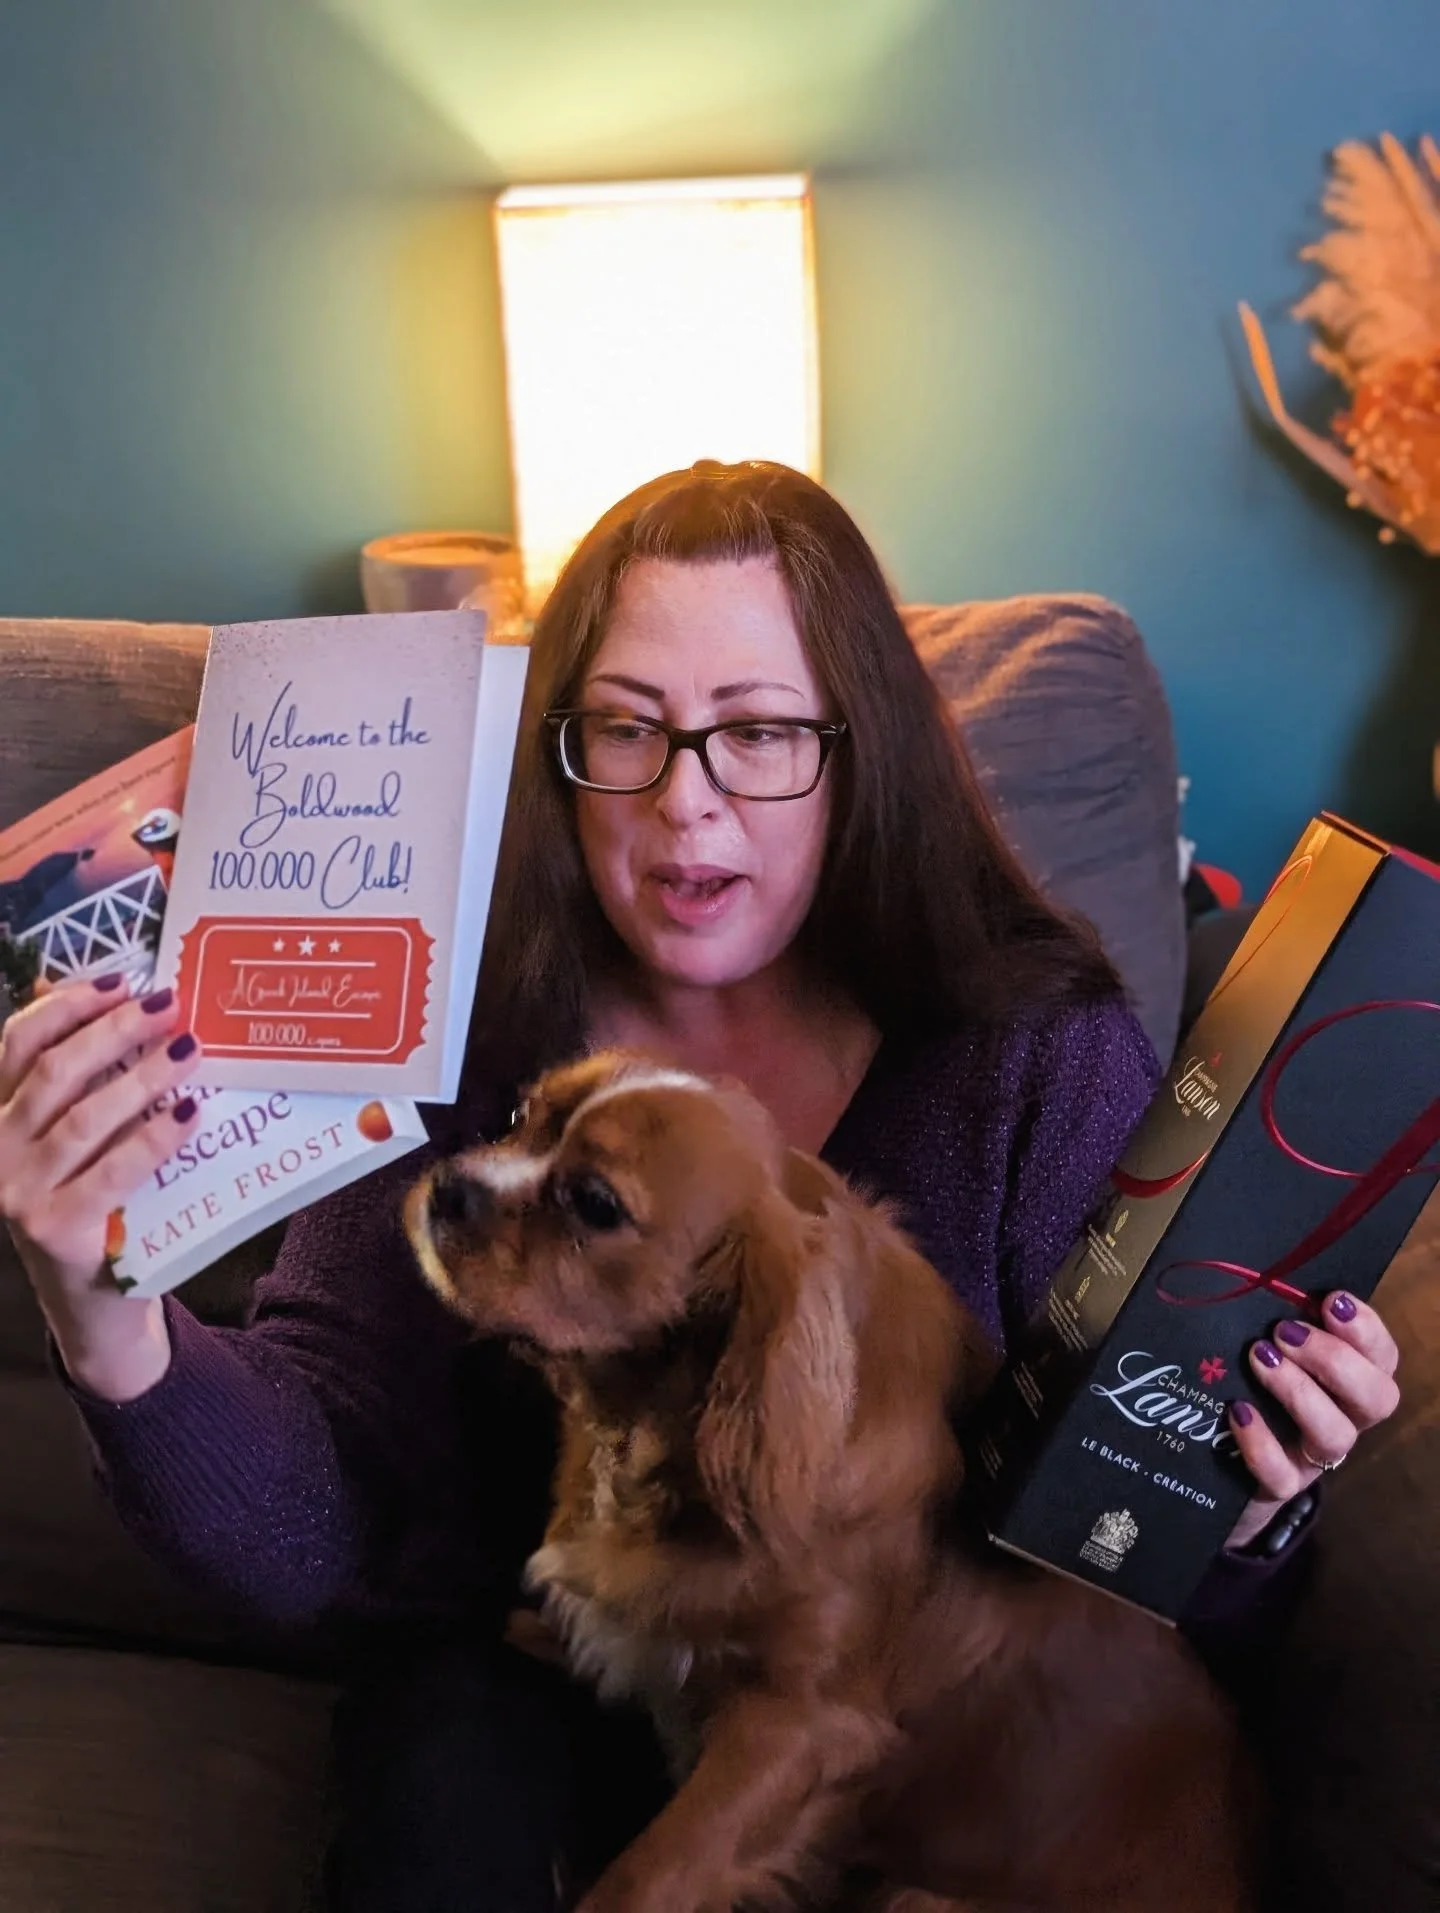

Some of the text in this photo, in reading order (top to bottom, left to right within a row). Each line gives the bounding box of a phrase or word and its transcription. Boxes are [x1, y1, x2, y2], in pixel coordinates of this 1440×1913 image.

[231, 681, 431, 778] Welcome to the
[240, 762, 402, 848] Boldwood
[320, 835, 413, 909] Club!
[140, 1122, 345, 1258] KATE FROST
[1157, 1374, 1225, 1415] CHAMPAG
[1081, 1437, 1097, 1451] LE
[1099, 1445, 1140, 1473] BLACK
[1157, 1431, 1185, 1452] 1760
